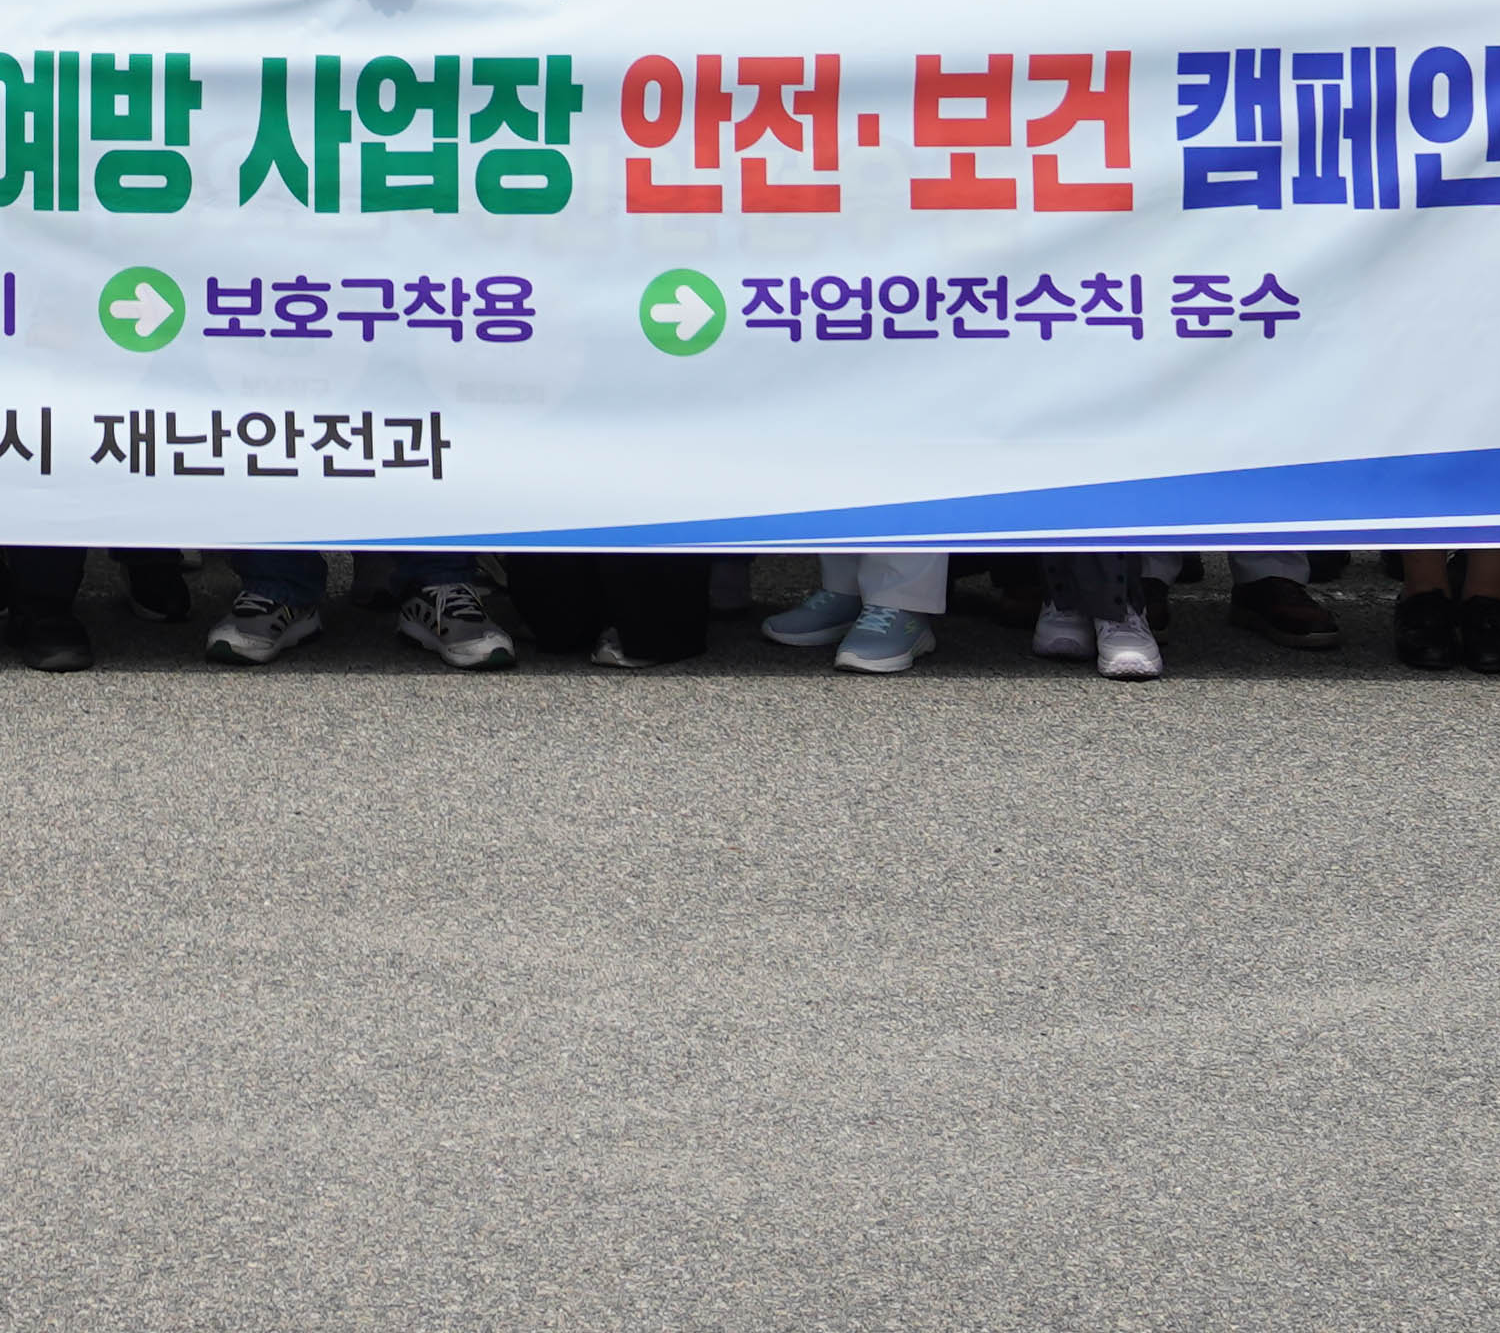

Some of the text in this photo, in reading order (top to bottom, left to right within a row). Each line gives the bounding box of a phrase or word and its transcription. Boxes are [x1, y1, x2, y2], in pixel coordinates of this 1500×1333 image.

[238, 53, 585, 216] 사업장
[201, 273, 537, 344] 보호구착용
[740, 271, 1302, 343] 작업안전수칙 준수
[90, 408, 452, 481] 재난안전과
